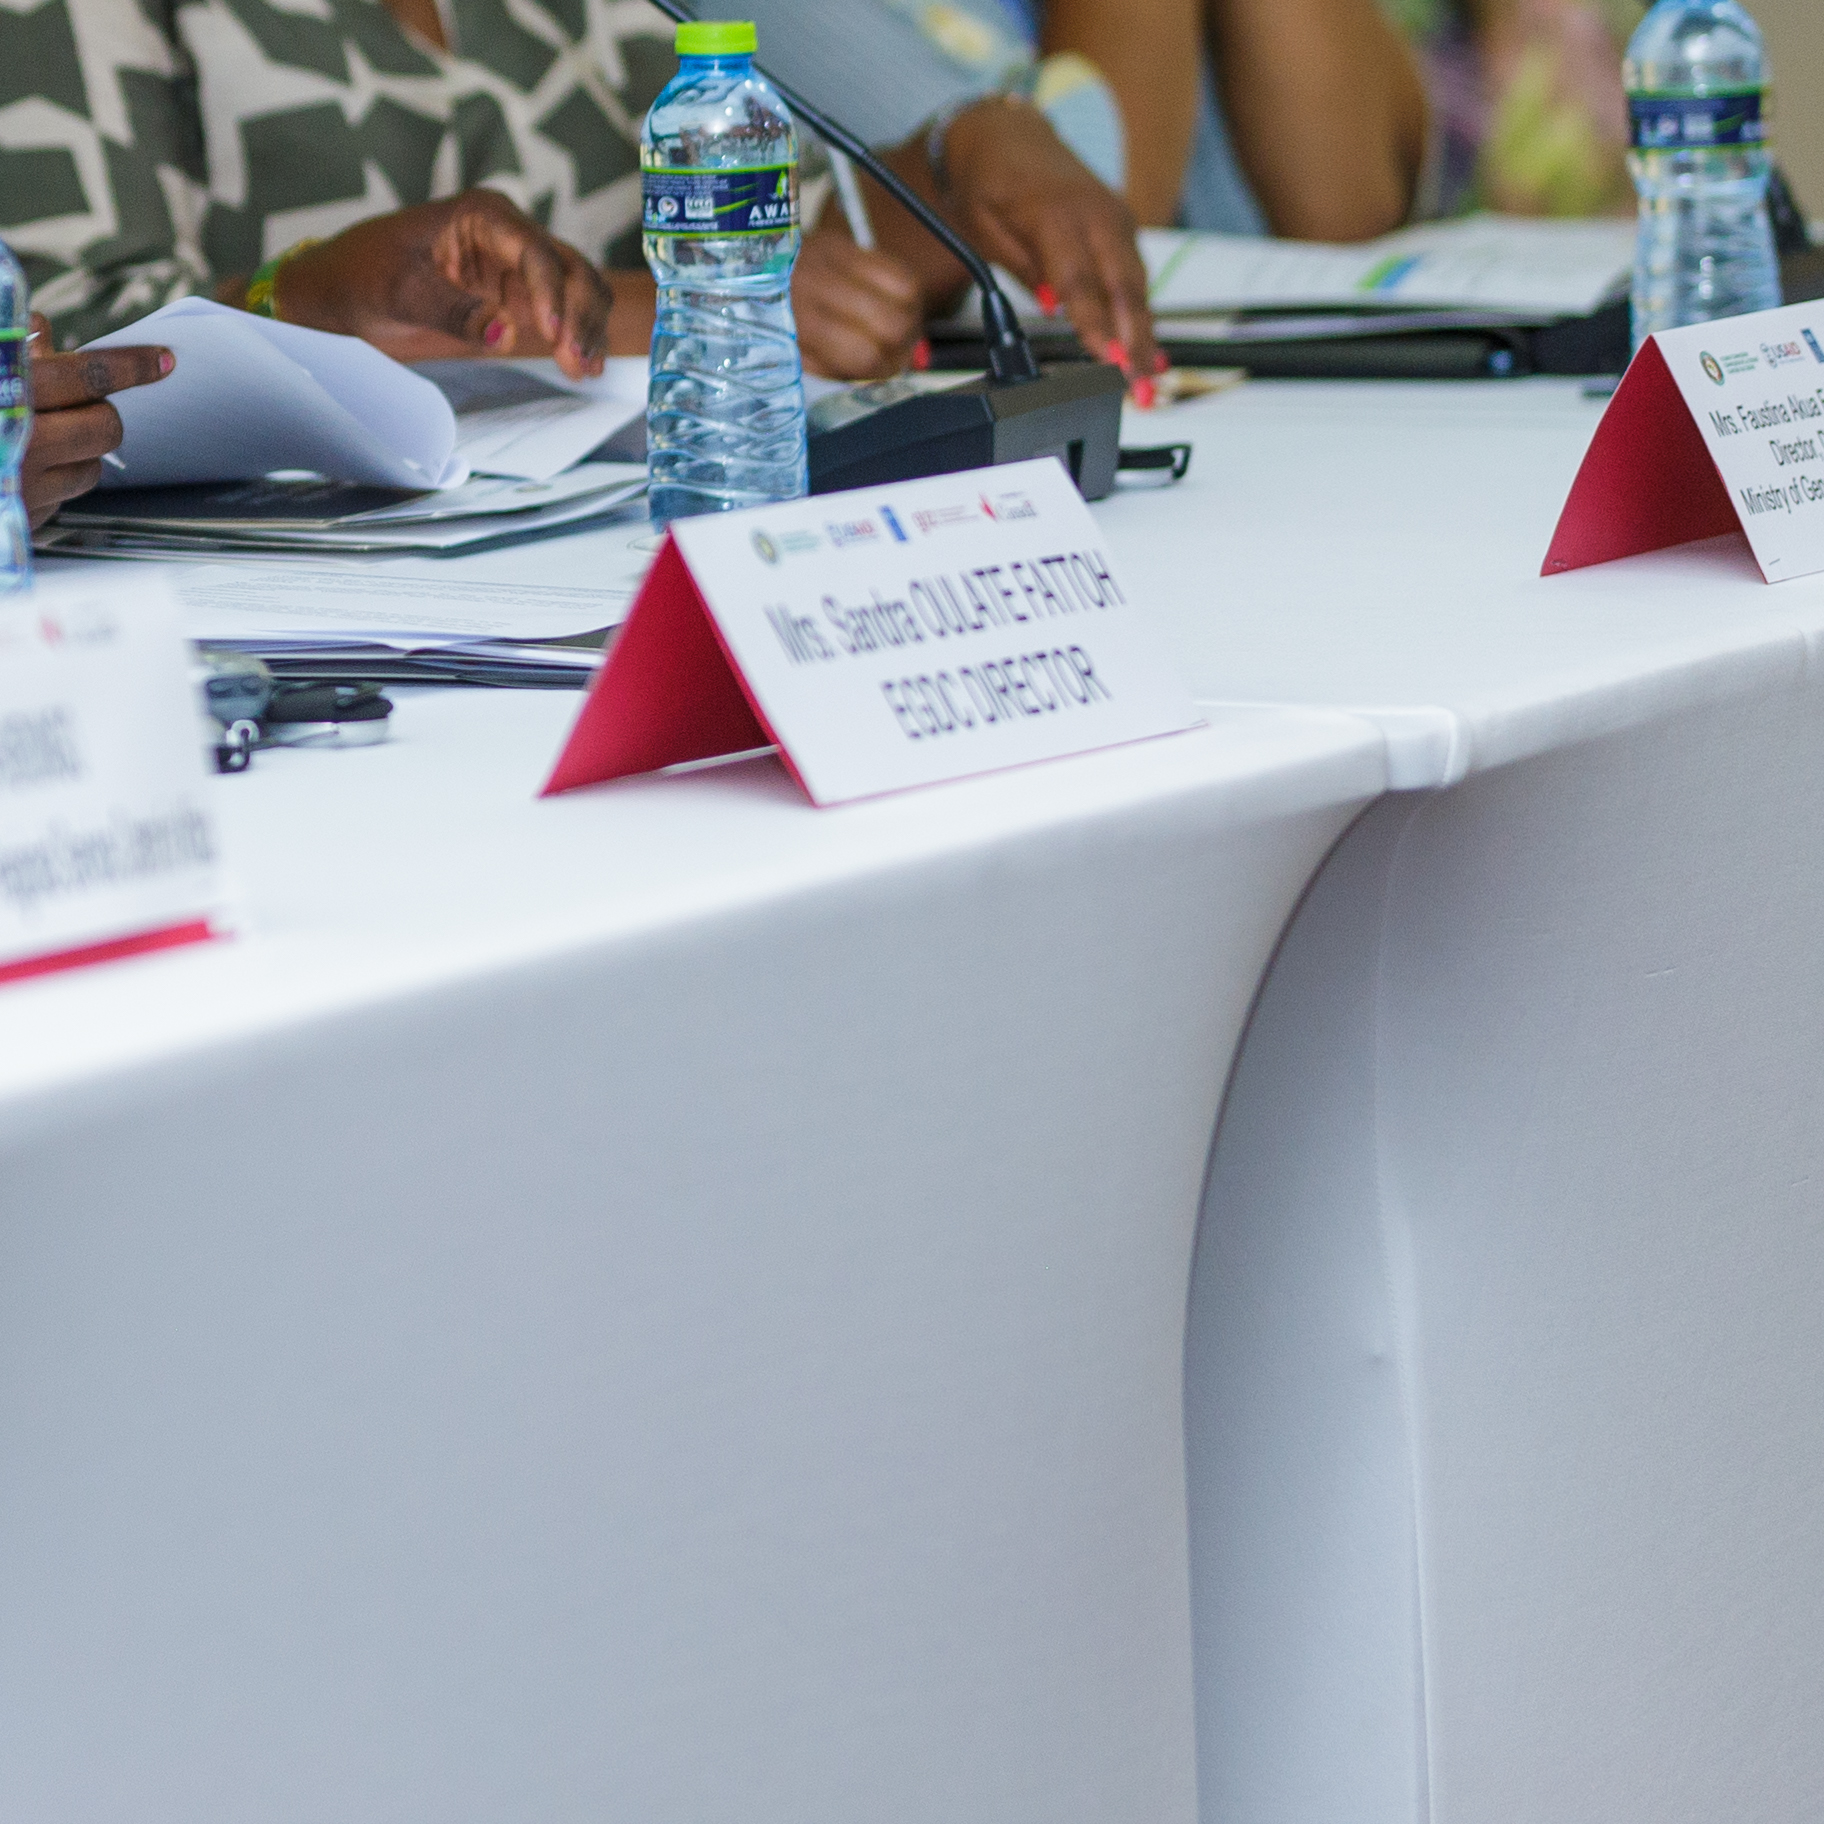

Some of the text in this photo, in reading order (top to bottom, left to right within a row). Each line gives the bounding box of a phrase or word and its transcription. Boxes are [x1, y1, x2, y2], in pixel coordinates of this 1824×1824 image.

[1708, 409, 1742, 437] Mrs.
[1736, 399, 1791, 432] Faustina
[1740, 483, 1792, 516] Ministry
[1789, 477, 1805, 505] of
[762, 603, 834, 666] Mrs.
[819, 587, 924, 656] Sandra
[957, 644, 1113, 724] DIRECTOR
